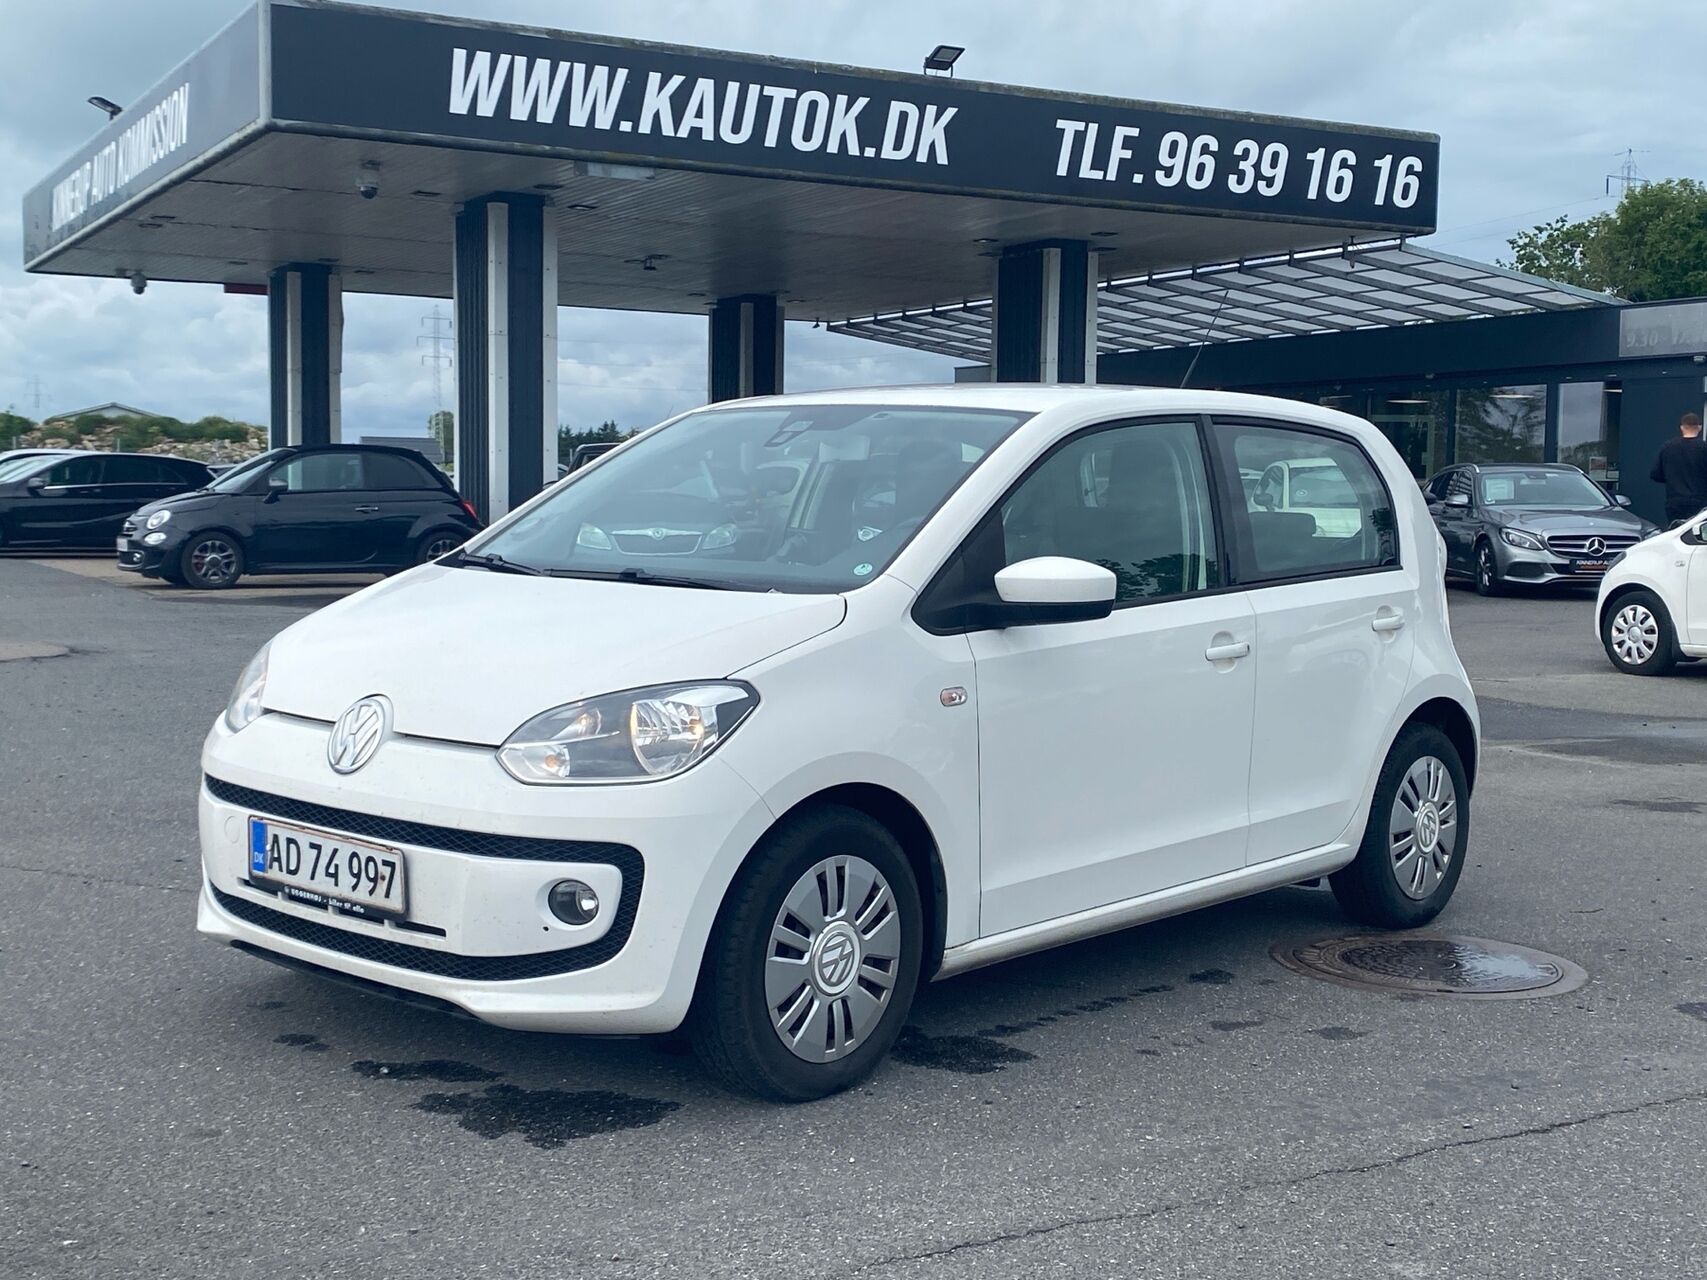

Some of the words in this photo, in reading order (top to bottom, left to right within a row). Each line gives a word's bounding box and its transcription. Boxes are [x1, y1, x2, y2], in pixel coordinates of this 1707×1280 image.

[117, 82, 190, 188] KOMMISSION
[449, 47, 958, 165] WWW.KAUTOK.DK
[1055, 119, 1144, 184] TLF.
[1155, 131, 1219, 190] 96
[1227, 139, 1289, 196] 39
[1306, 147, 1357, 203] 16
[1373, 154, 1423, 209] 16
[254, 852, 264, 864] DK
[269, 833, 301, 876] AD
[309, 842, 339, 887] 74
[348, 851, 396, 899] 997
